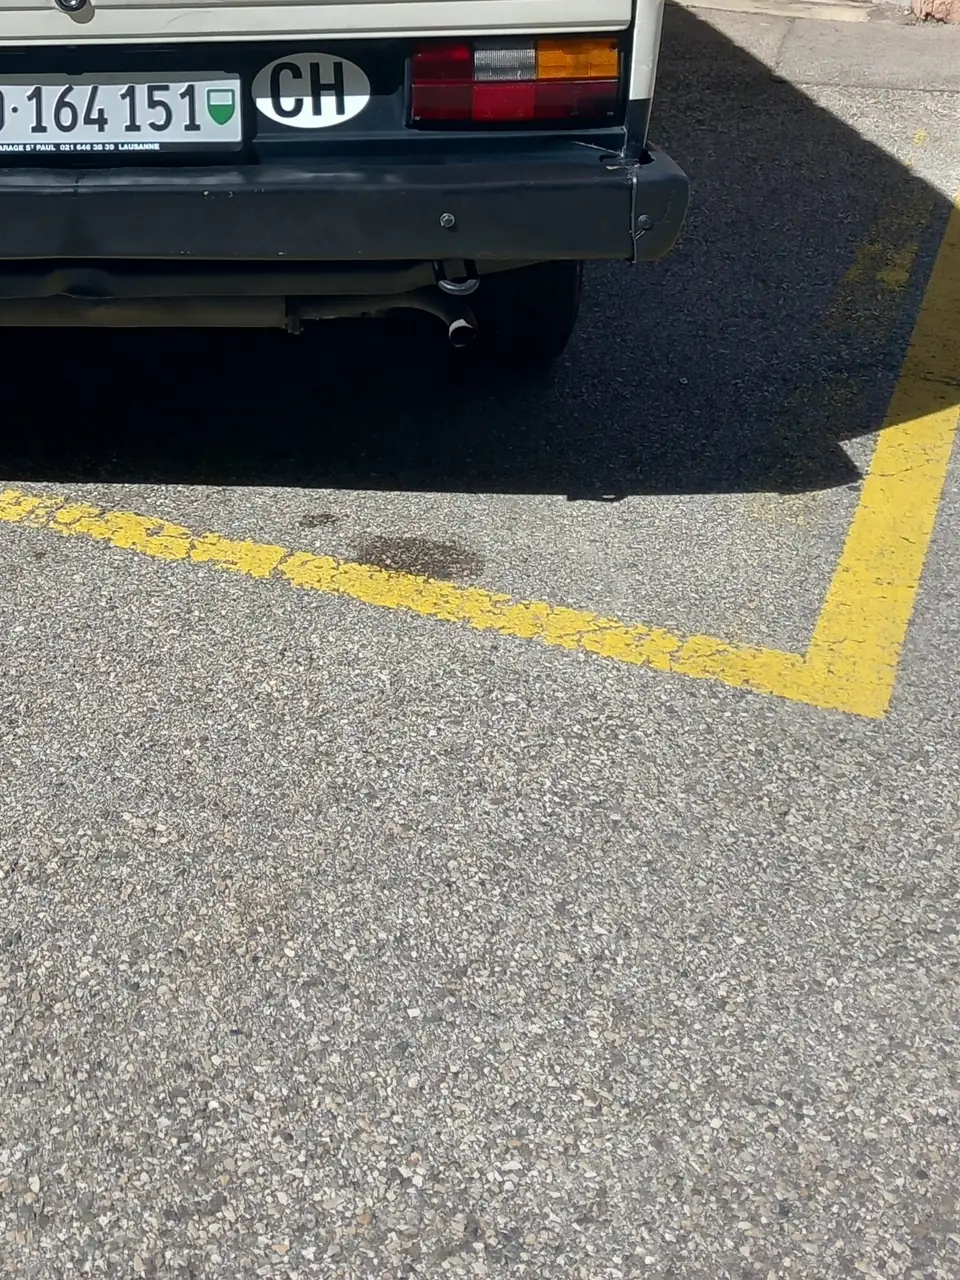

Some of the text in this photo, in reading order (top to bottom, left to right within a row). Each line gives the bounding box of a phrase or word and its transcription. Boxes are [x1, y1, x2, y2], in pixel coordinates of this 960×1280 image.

[270, 62, 344, 119] CH
[36, 143, 56, 151] PAUL
[60, 143, 74, 151] 021
[77, 143, 91, 151] 646
[93, 143, 103, 151] 38
[105, 143, 115, 151] 39
[118, 142, 160, 150] LAUSANNE
